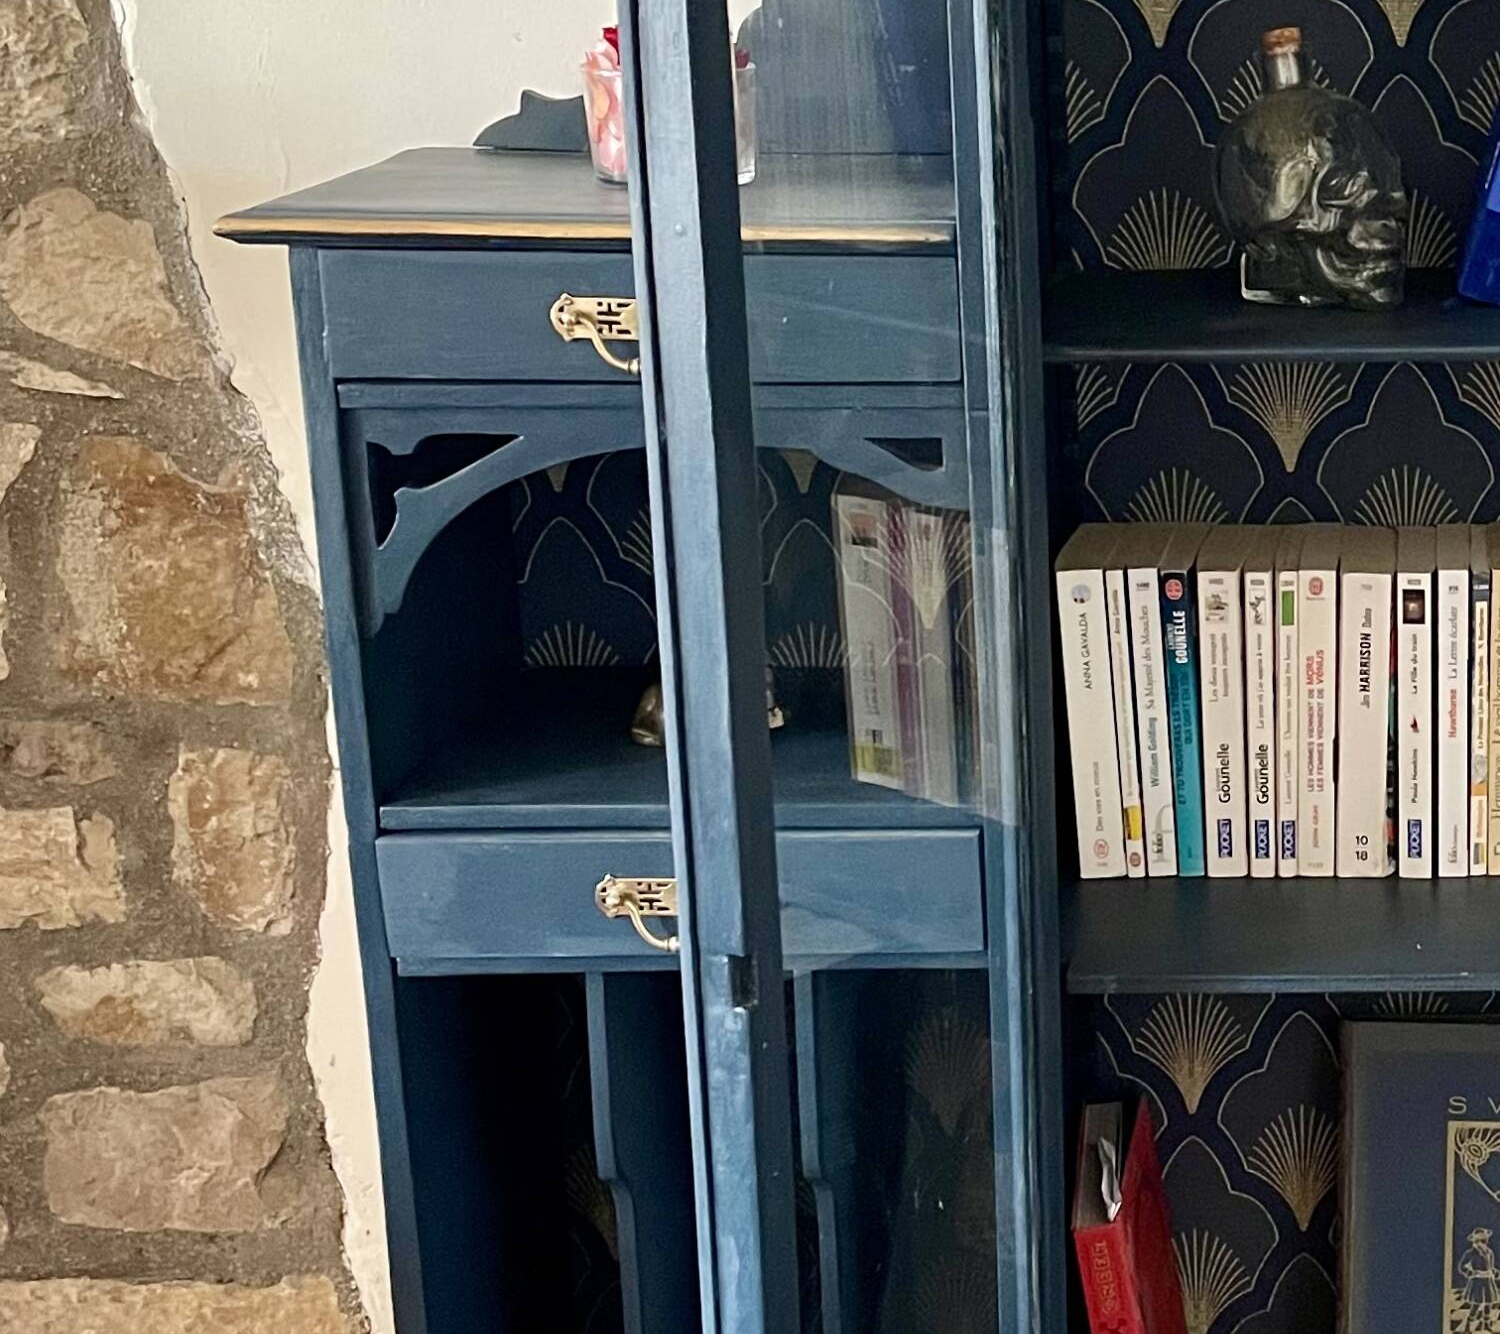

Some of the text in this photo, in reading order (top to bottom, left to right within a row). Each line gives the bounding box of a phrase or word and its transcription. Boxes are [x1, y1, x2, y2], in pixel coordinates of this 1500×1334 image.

[1078, 612, 1092, 689] ANNA GAVALDA
[1172, 610, 1187, 663] GOUNELLE
[1142, 647, 1152, 661] des
[1359, 633, 1370, 691] HARRISON
[1410, 653, 1418, 664] du
[1409, 666, 1417, 683] Fille
[1412, 684, 1418, 695] La
[1448, 668, 1458, 679] La
[1144, 698, 1155, 709] Sa
[1306, 688, 1314, 698] DE
[1315, 688, 1324, 698] DE
[1306, 701, 1314, 738] VIENNENT
[1315, 701, 1324, 739] VIENNENT
[1448, 688, 1457, 738] Hawthorne
[1146, 716, 1159, 787] William Golding
[1306, 741, 1314, 776] HOMMES
[1315, 742, 1324, 775] FEMMES
[1215, 743, 1230, 803] Gounelle
[1254, 744, 1268, 804] Gounelle
[1306, 777, 1315, 792] LES
[1315, 777, 1324, 792] LES
[1410, 782, 1418, 803] Paula
[1219, 819, 1230, 857] POCKET
[1257, 820, 1267, 858] POCKET
[1283, 821, 1294, 859] POCKET
[1355, 835, 1368, 846] 10
[1409, 819, 1420, 858] POCKET
[1355, 851, 1368, 861] 18
